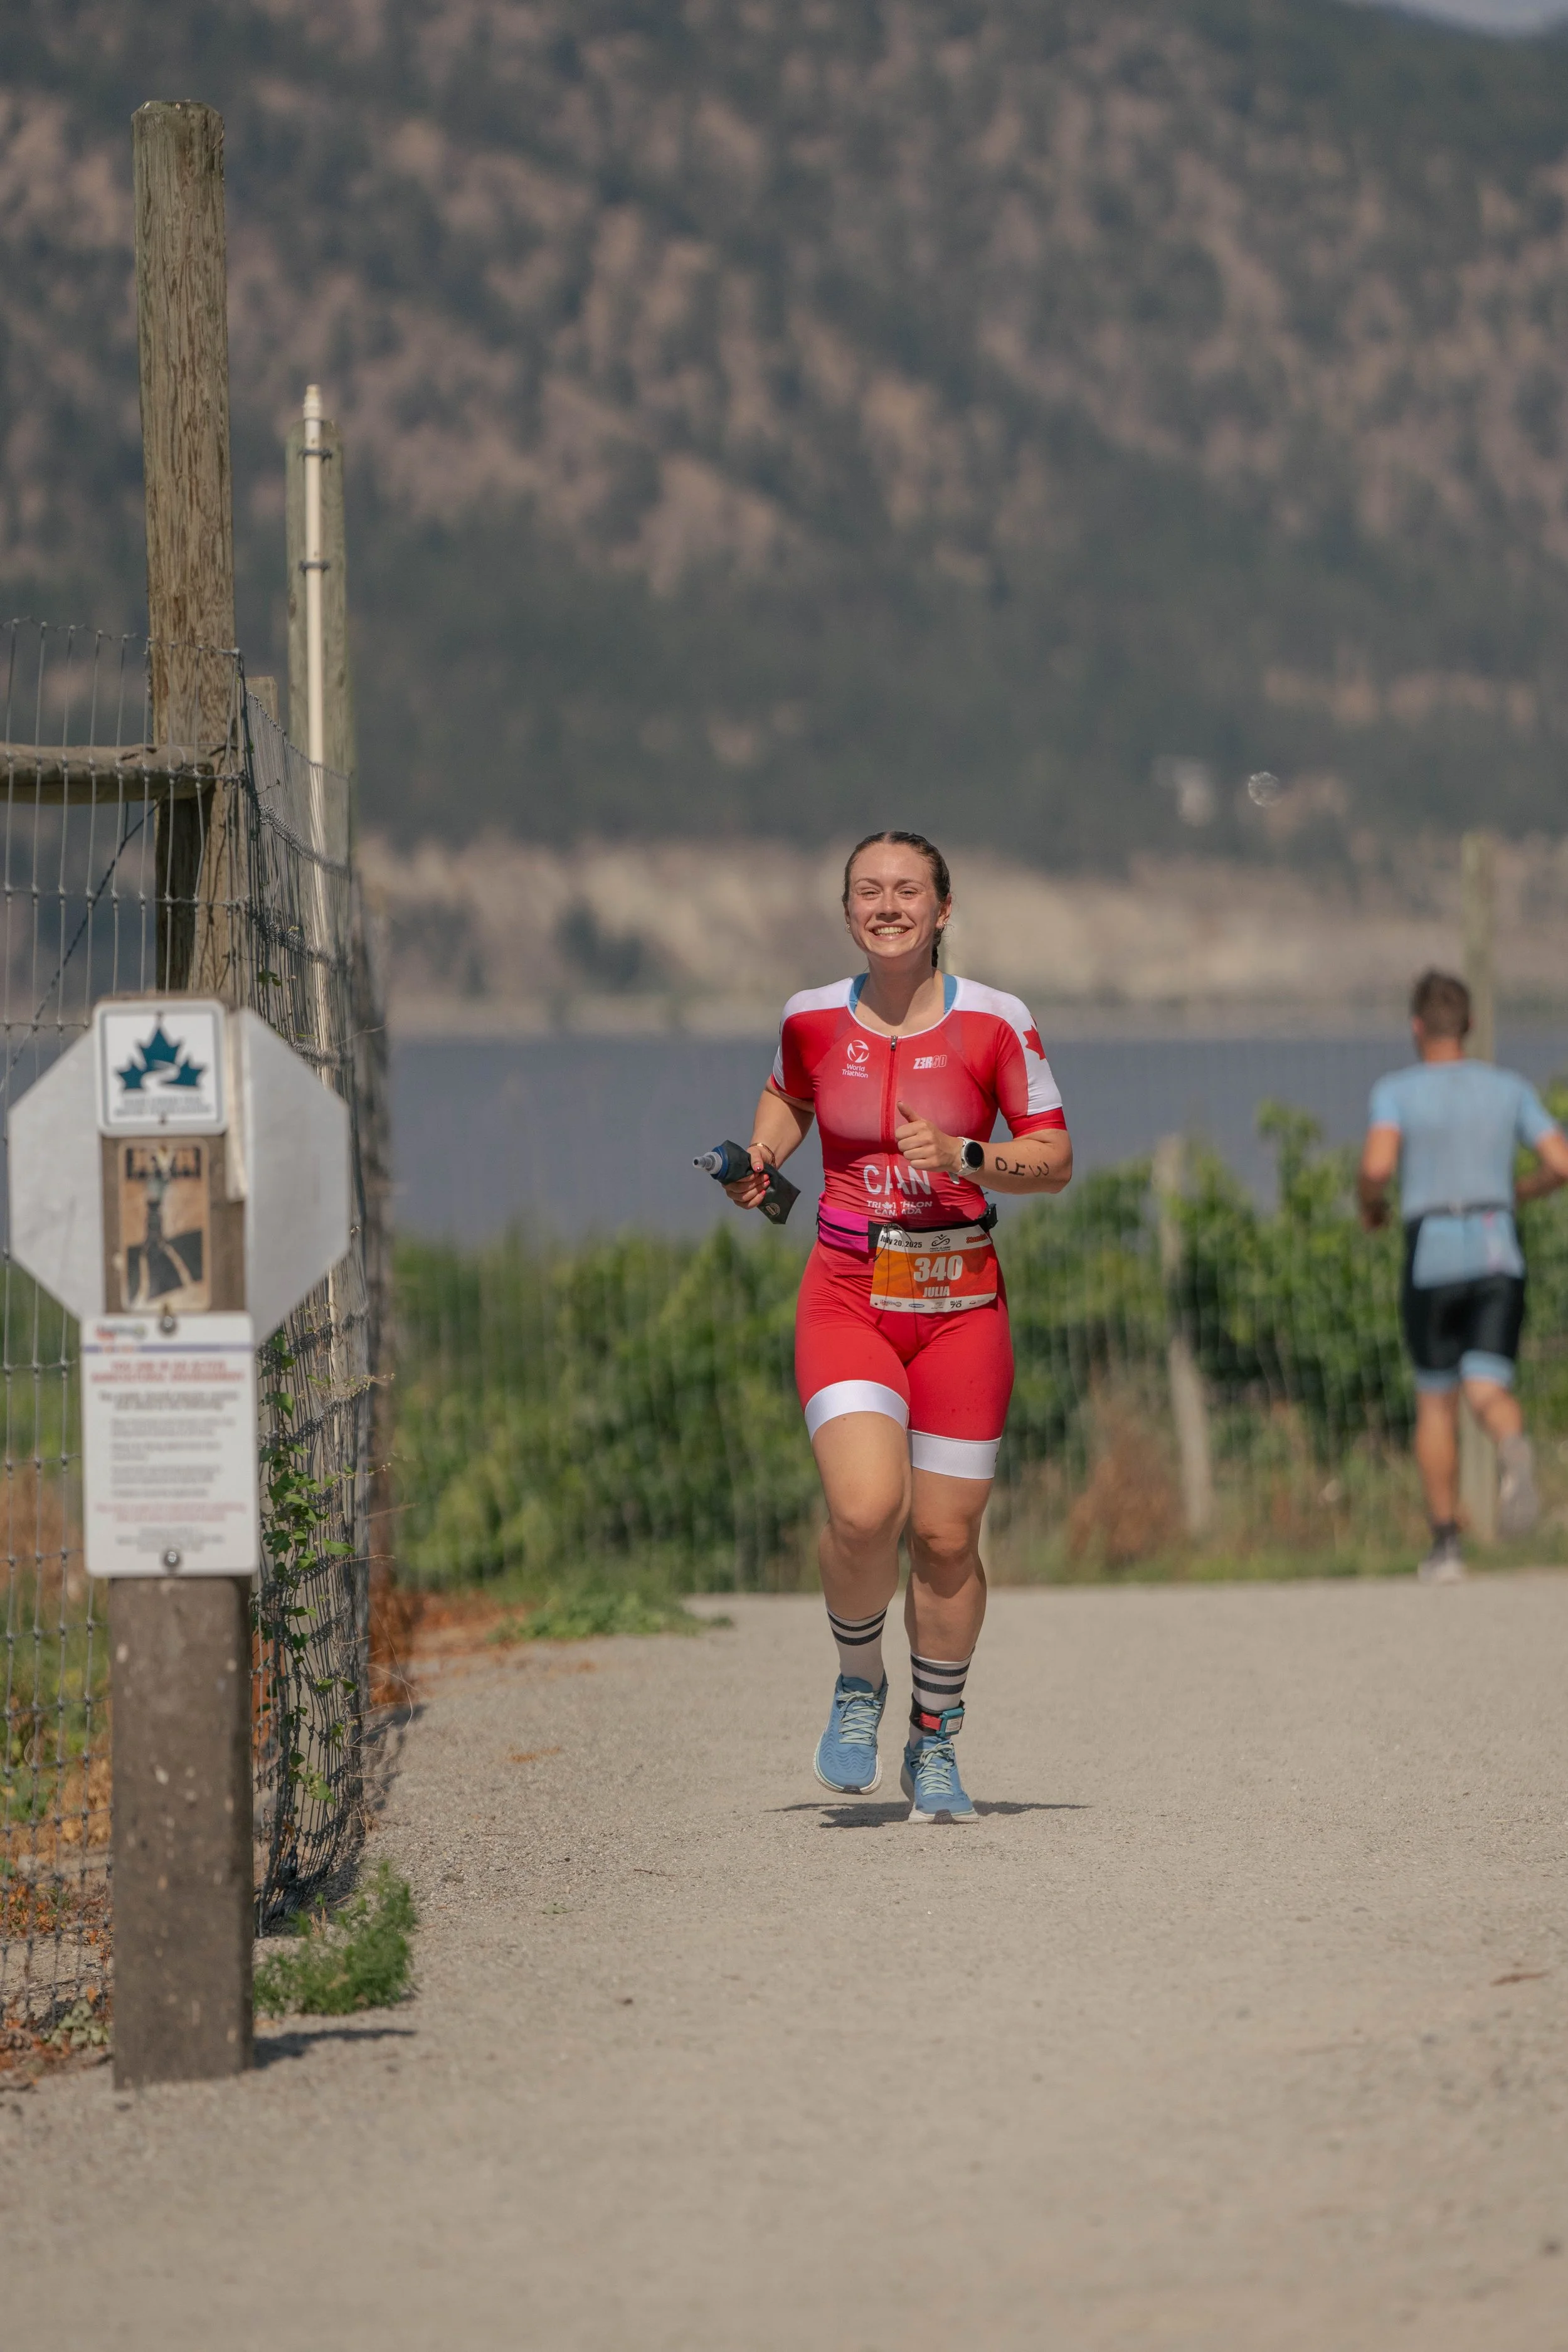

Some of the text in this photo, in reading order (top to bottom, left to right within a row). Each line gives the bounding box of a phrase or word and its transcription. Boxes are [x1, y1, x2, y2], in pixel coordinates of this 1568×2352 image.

[847, 1063, 866, 1072] World
[842, 1069, 869, 1078] Triathlon
[863, 1164, 932, 1195] CAN
[894, 1239, 904, 1248] 20,
[913, 1255, 963, 1282] 340
[923, 1286, 950, 1298] JULIA
